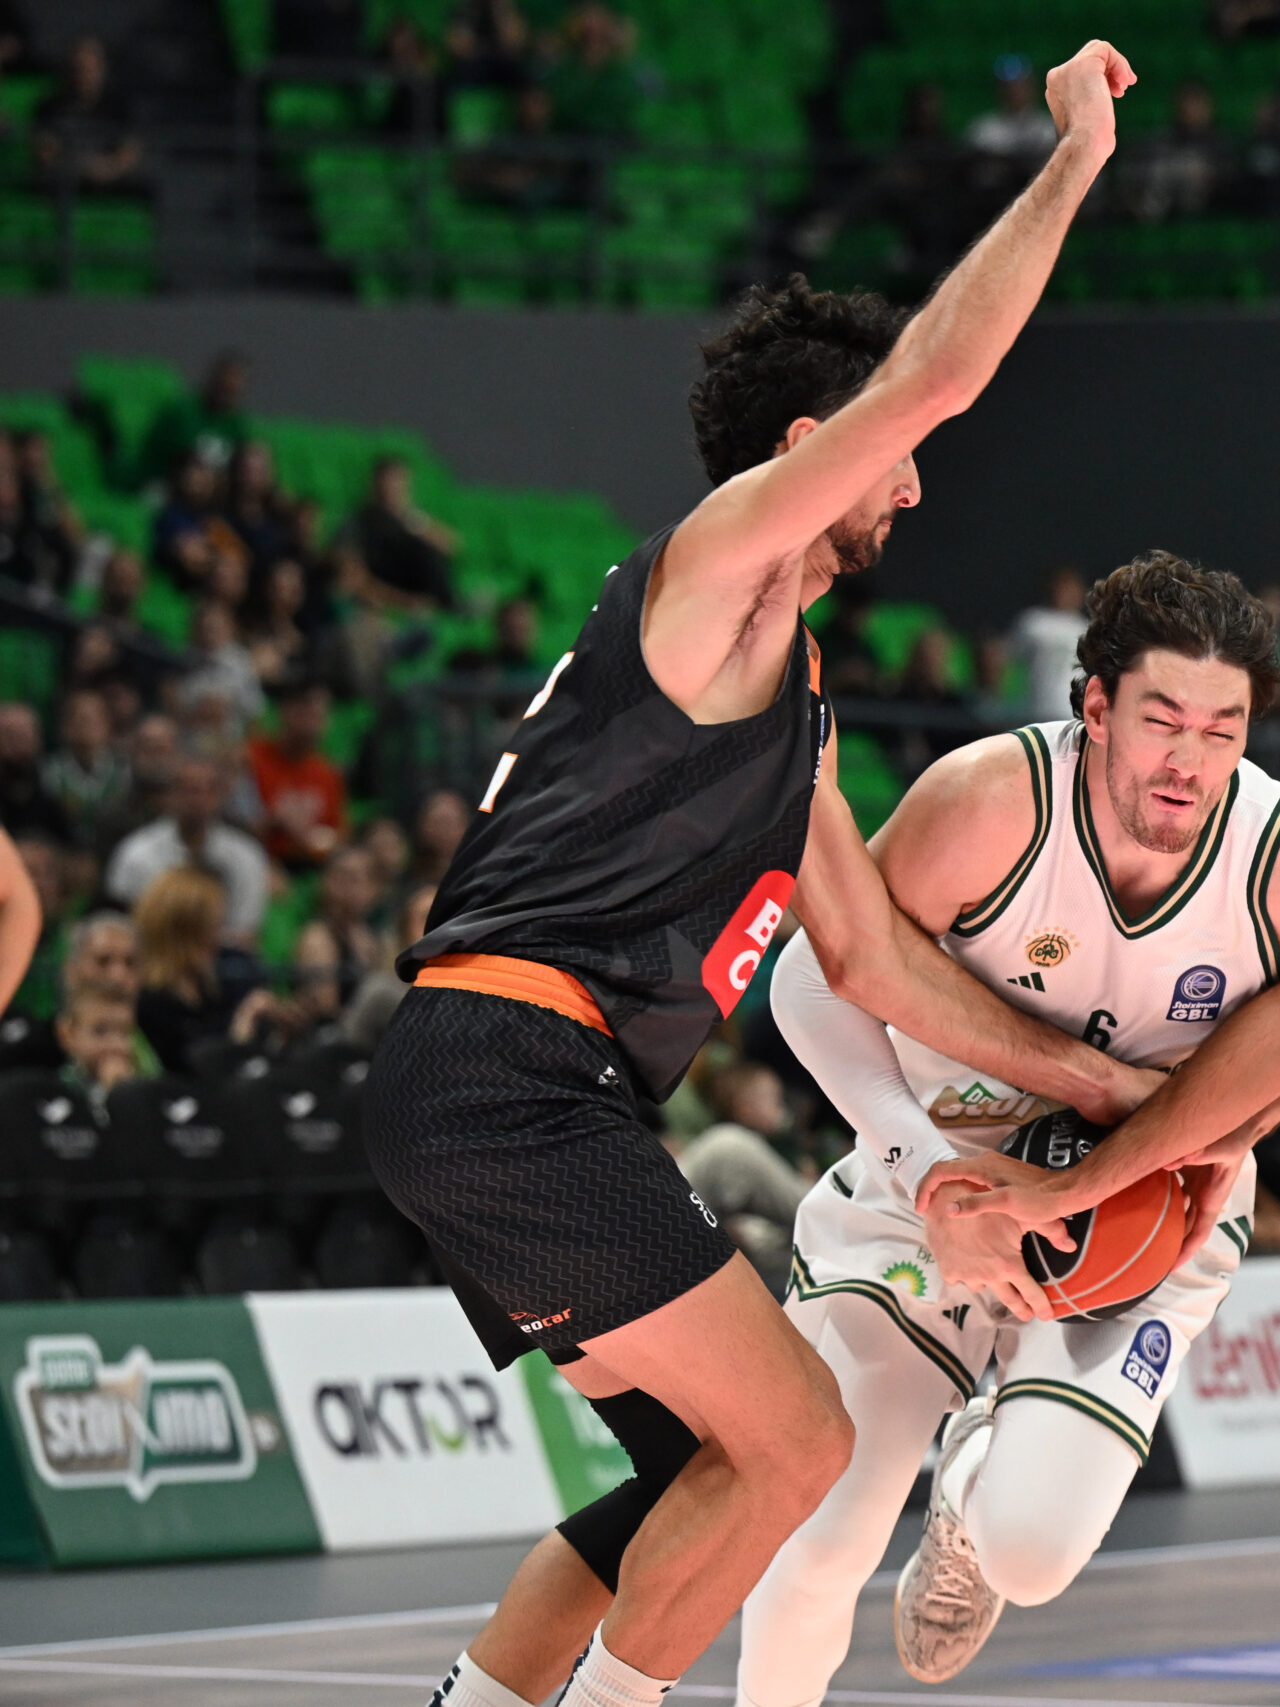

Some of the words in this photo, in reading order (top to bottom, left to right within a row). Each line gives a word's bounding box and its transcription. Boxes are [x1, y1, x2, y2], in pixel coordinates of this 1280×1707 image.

[1170, 1008, 1214, 1022] GBL
[1171, 1000, 1220, 1010] Stoiximan
[1082, 1008, 1118, 1052] 6
[519, 1307, 573, 1333] eocar
[1125, 1361, 1154, 1397] GBL
